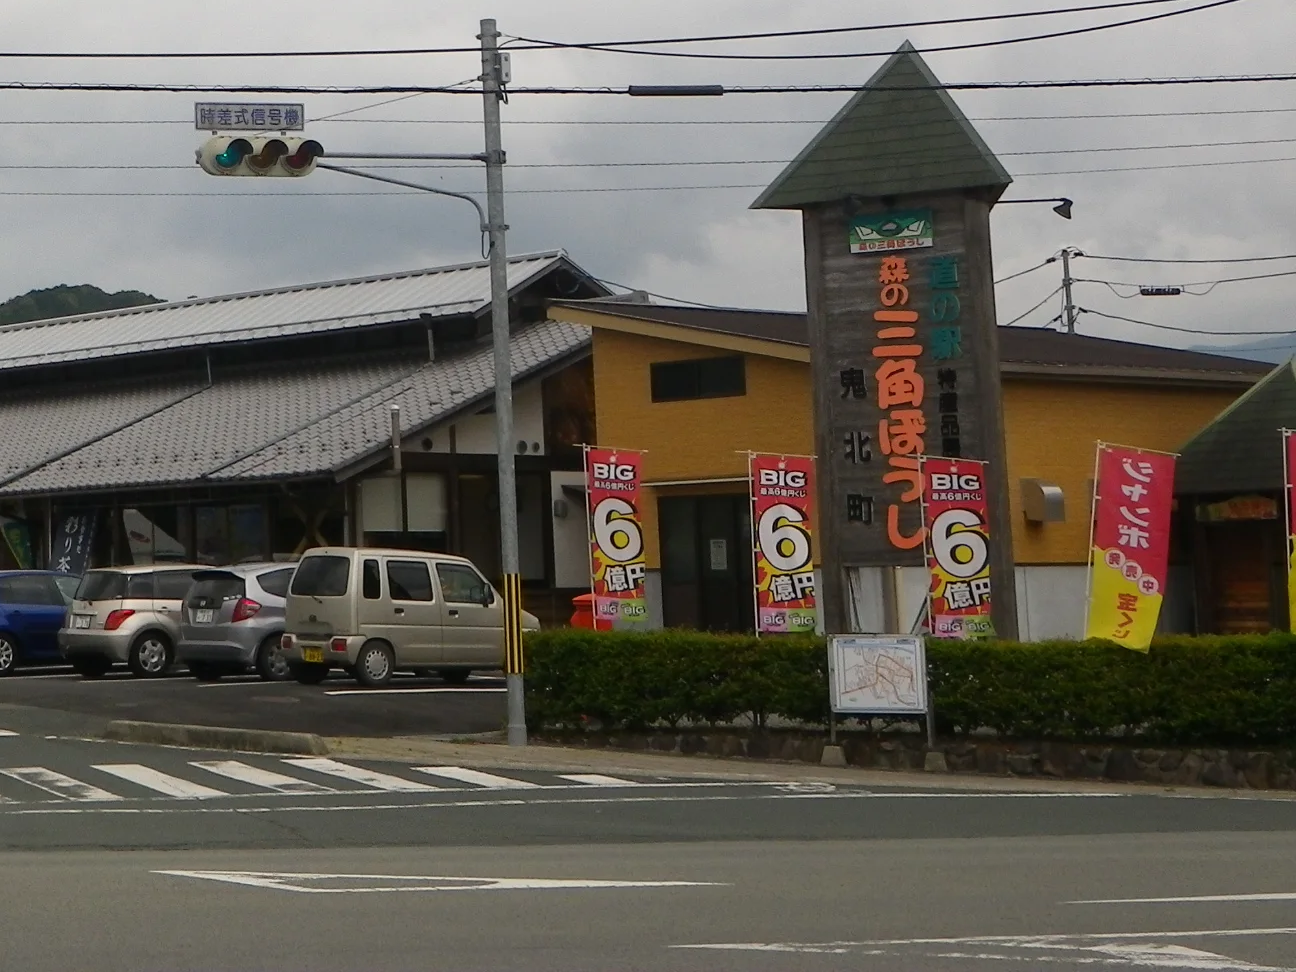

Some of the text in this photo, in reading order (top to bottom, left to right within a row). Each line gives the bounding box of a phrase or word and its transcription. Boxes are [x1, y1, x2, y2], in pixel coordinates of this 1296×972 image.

[200, 108, 300, 126] 時差式信号機
[859, 238, 925, 251] 森の三角ぼうし
[929, 256, 962, 360] 道の駅
[872, 256, 929, 549] 森の三角ぼうし
[840, 368, 875, 526] 鬼北町
[593, 462, 635, 481] BIG
[759, 469, 807, 487] BIG
[594, 481, 635, 491] 最高6億円くじ
[930, 473, 981, 491] BIG
[760, 488, 806, 498] 最高6億円くじ
[932, 492, 982, 501] 最高6億円くじ
